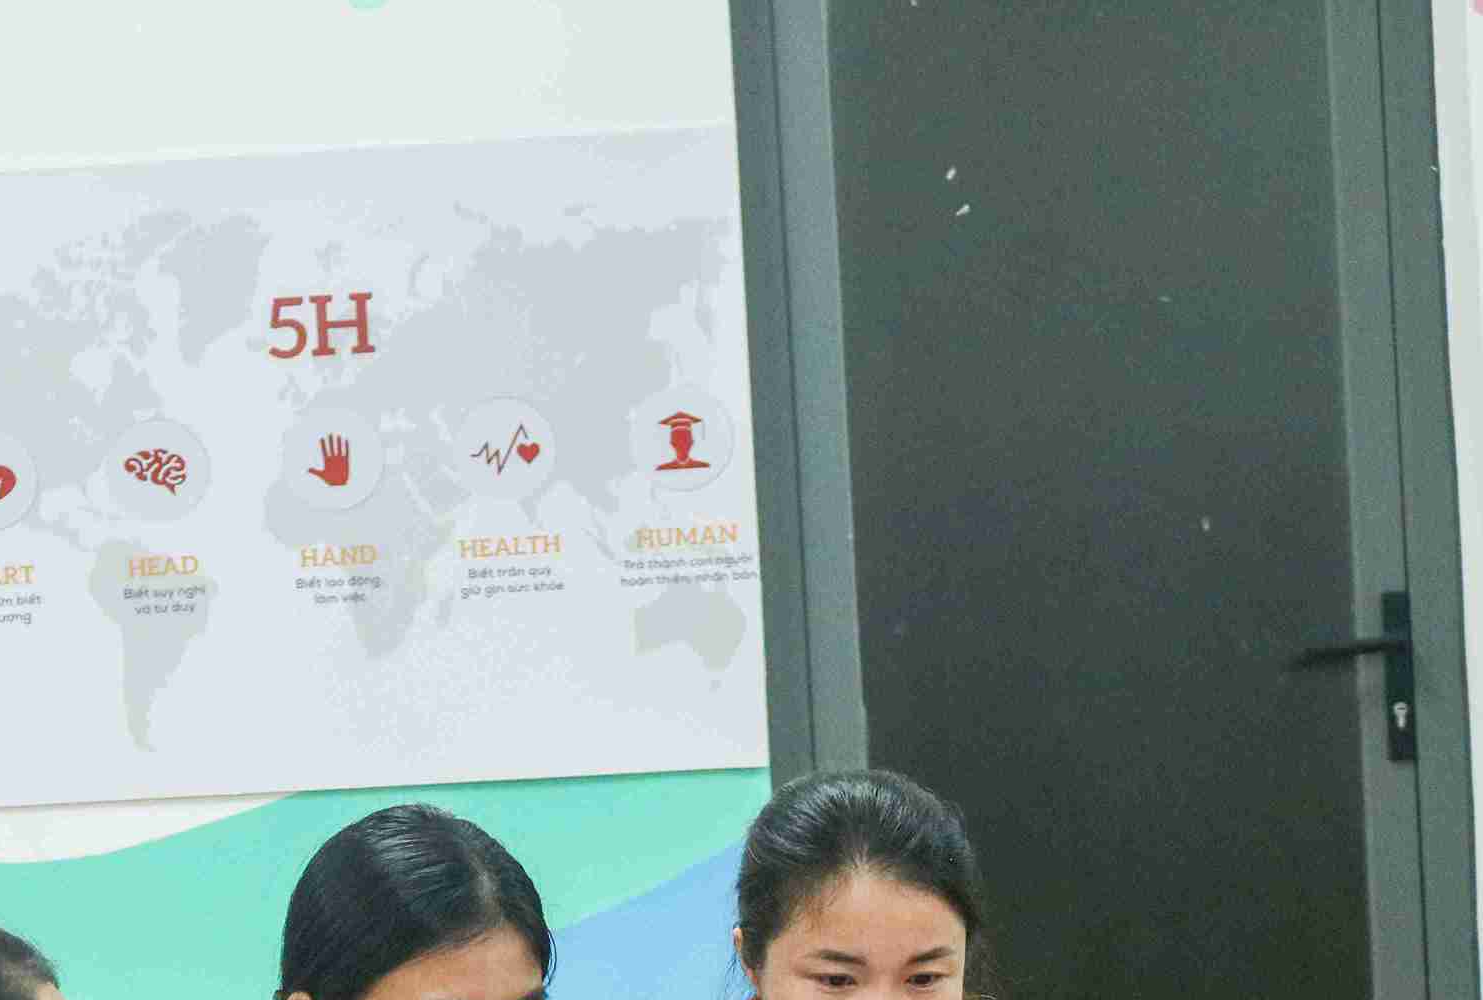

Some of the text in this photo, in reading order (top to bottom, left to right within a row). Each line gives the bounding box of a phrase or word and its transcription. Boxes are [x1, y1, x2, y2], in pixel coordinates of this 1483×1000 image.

[269, 291, 375, 359] 5H
[457, 533, 562, 558] HEALTH
[635, 524, 741, 549] HUMAN
[127, 554, 199, 578] HEAD
[300, 545, 377, 568] HAND
